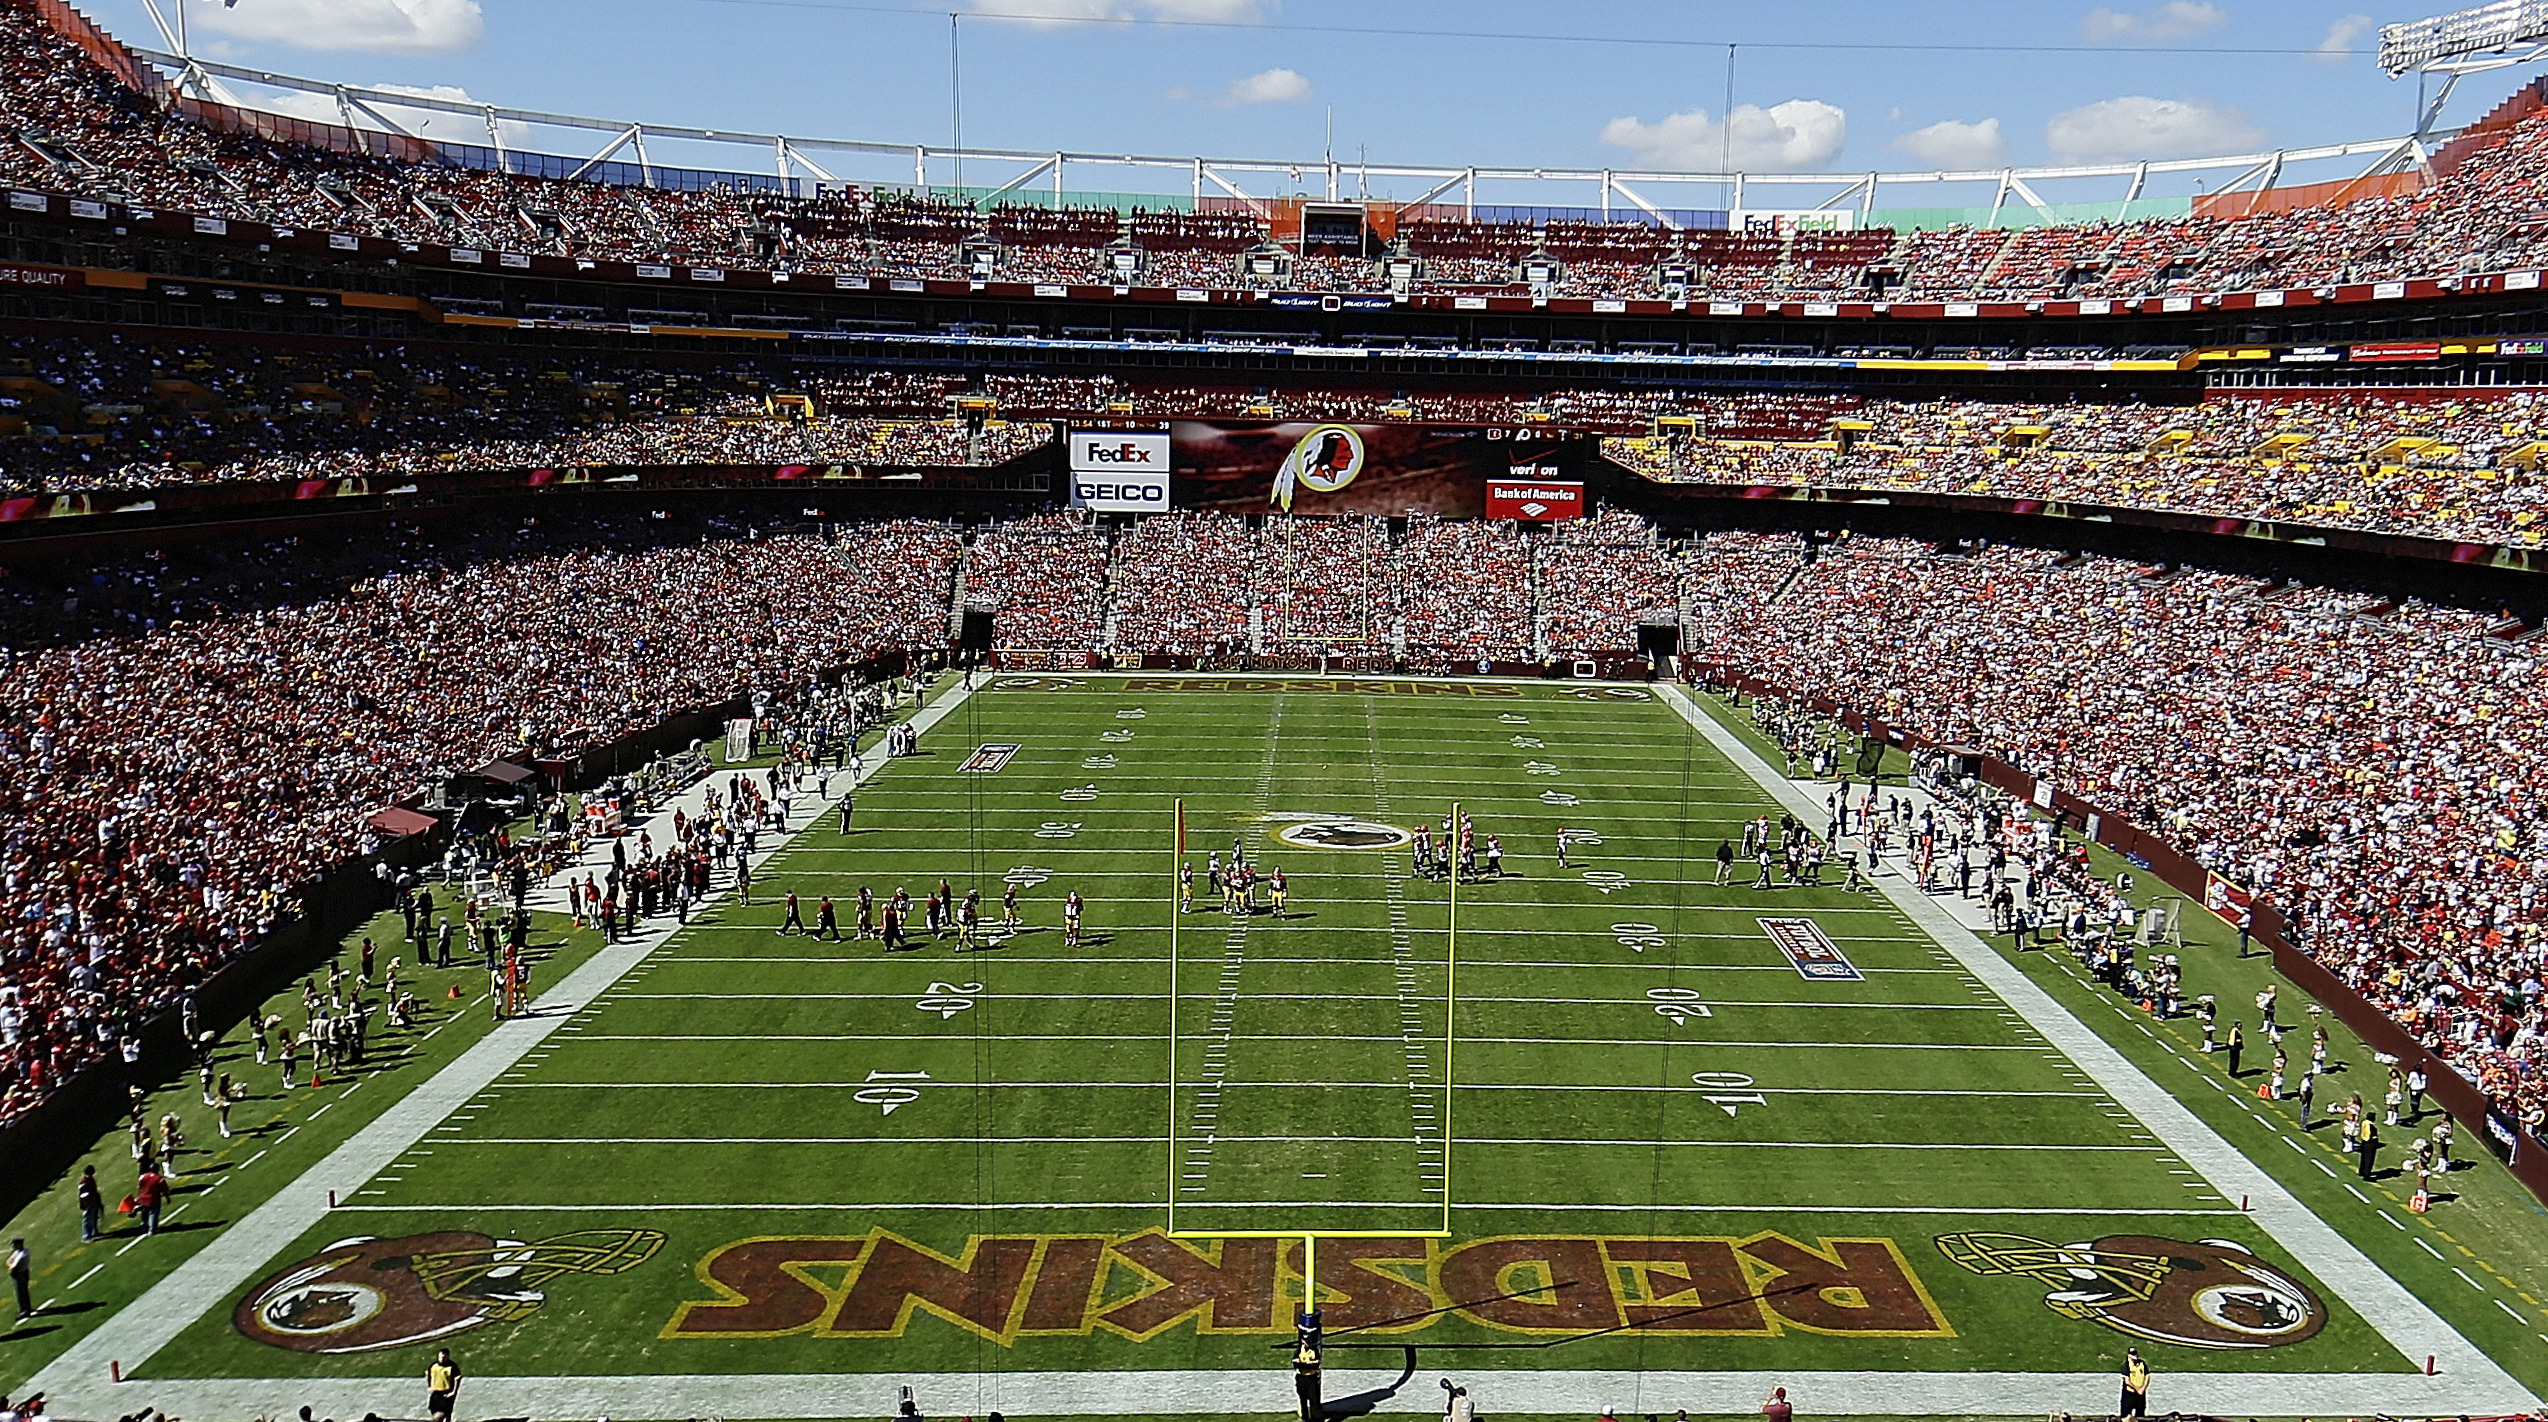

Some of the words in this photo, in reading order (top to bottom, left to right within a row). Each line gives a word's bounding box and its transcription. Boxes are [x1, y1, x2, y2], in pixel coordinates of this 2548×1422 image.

[1744, 214, 1838, 232] FedExField
[21, 271, 66, 285] QUALITY
[1088, 442, 1152, 463] FedEx
[1075, 483, 1163, 501] GEICO
[1122, 679, 1526, 698] REDSKINS
[1003, 865, 1053, 883] 40
[1582, 871, 1631, 890] 40
[1611, 923, 1667, 947] 30
[915, 982, 984, 1011] 20
[1646, 988, 1713, 1018] 20
[853, 1069, 931, 1104] 10
[1691, 1072, 1768, 1107] 10
[657, 1225, 1958, 1347] REDSKINS
